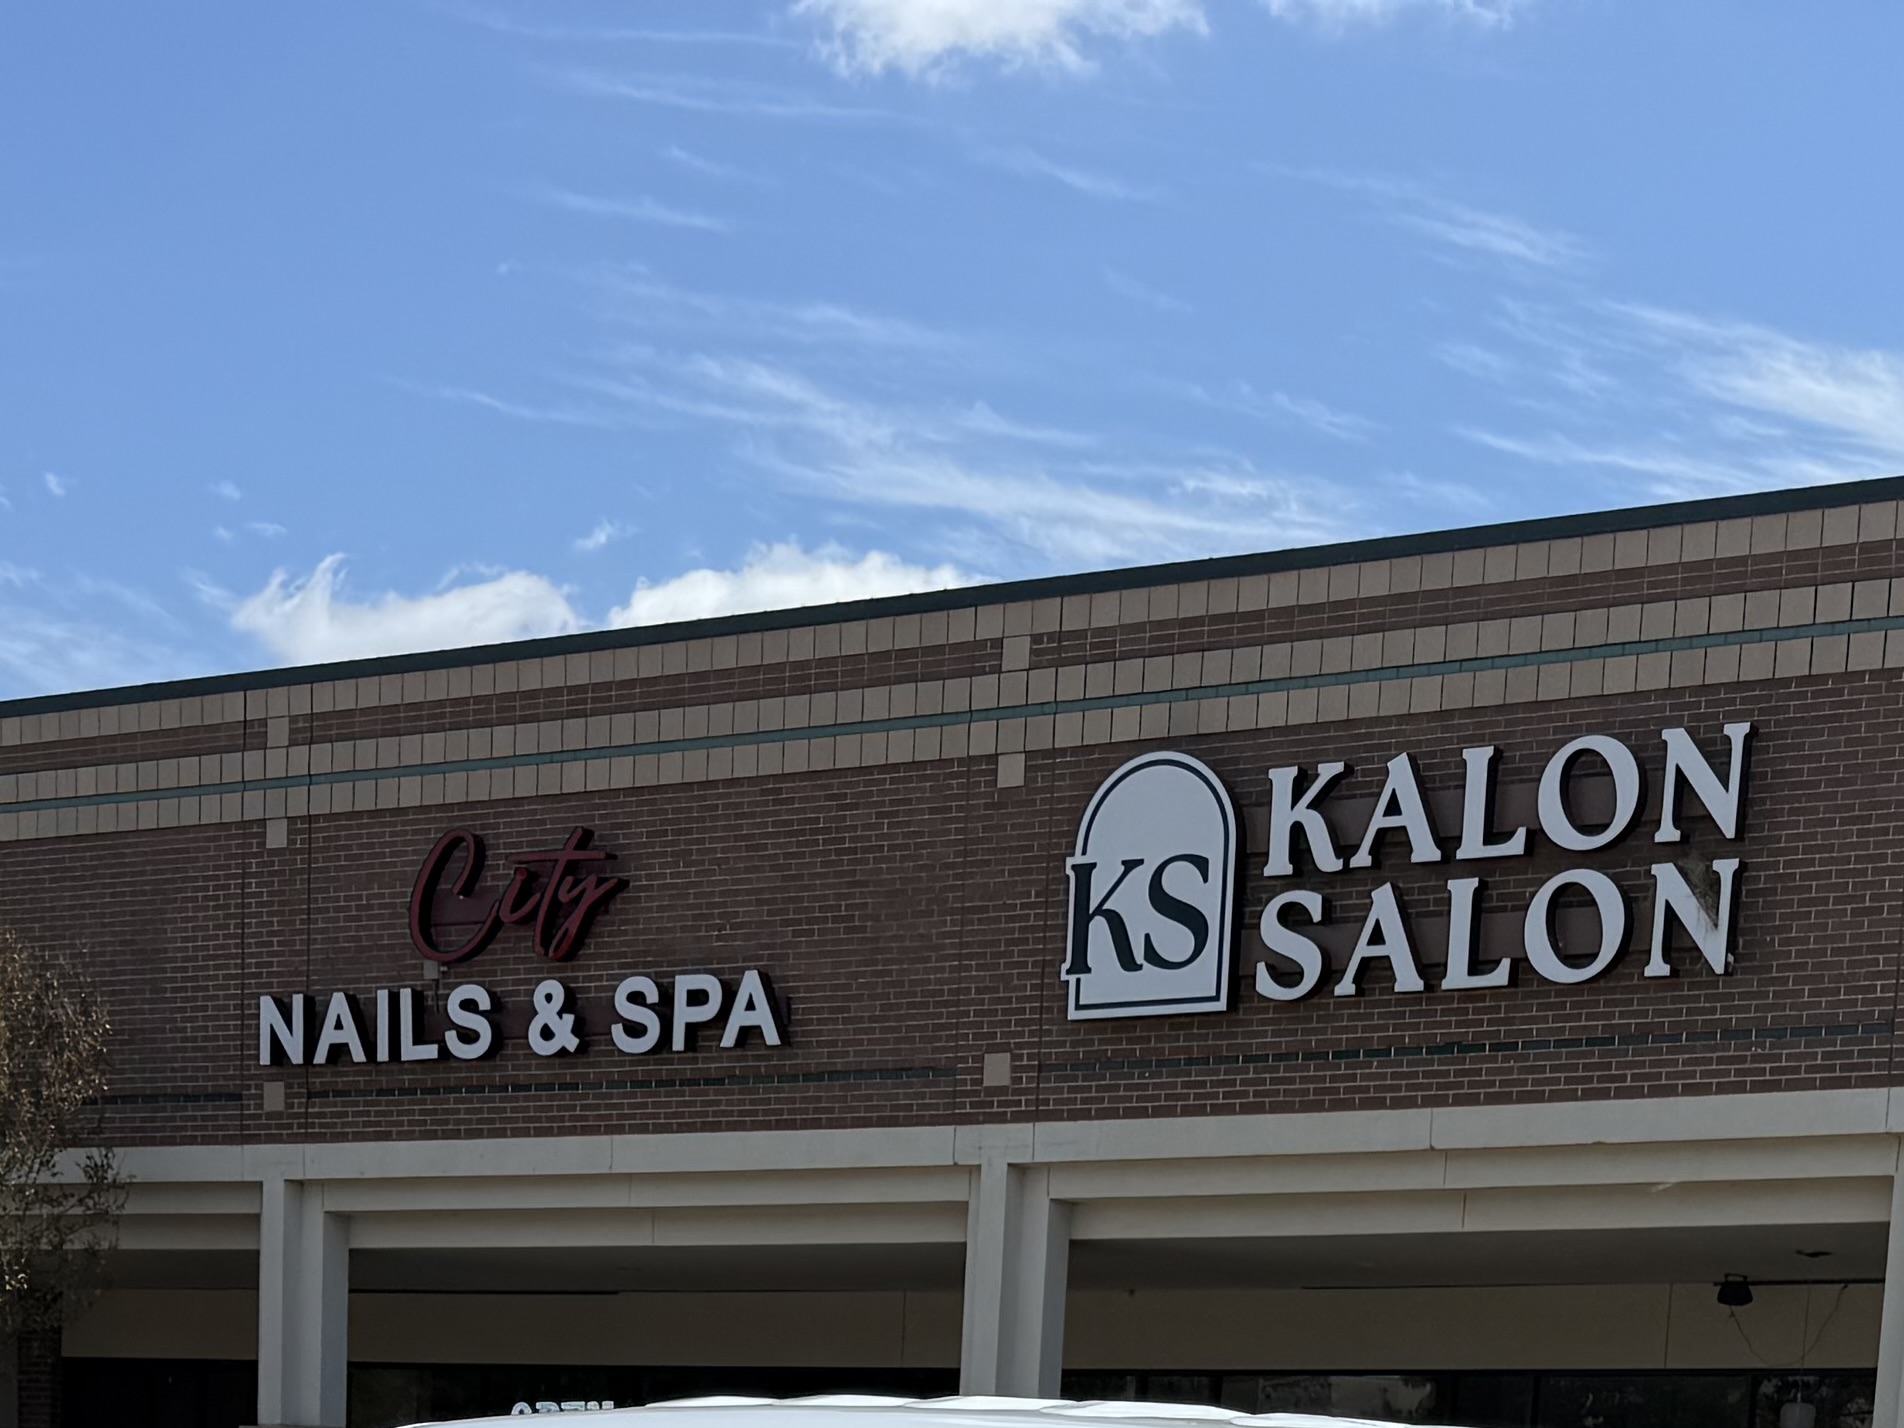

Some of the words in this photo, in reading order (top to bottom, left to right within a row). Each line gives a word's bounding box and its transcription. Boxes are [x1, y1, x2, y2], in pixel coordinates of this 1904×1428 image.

[1263, 721, 1753, 877] KALON
[410, 826, 619, 962] City
[1065, 854, 1210, 976] KS
[1255, 857, 1739, 1002] SALON
[258, 983, 493, 1066] NAILS
[528, 978, 580, 1056] &
[611, 969, 782, 1054] SPA
